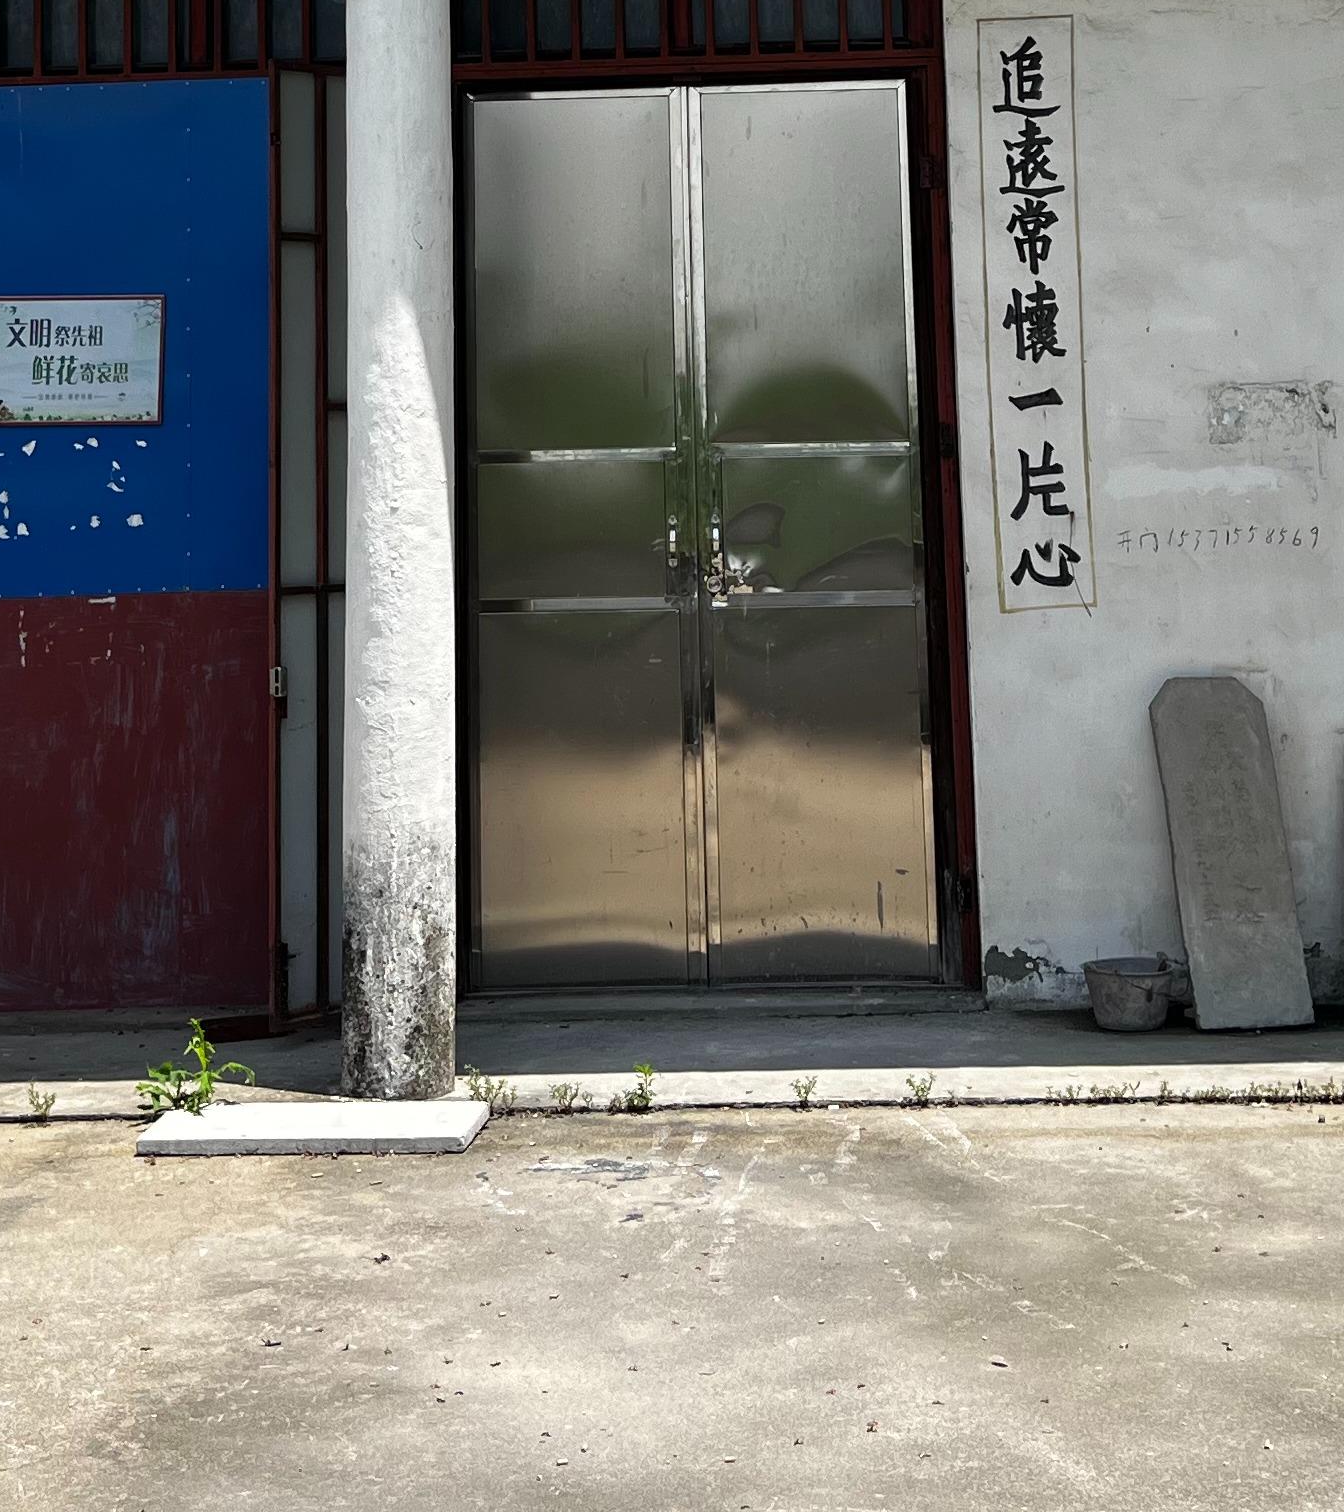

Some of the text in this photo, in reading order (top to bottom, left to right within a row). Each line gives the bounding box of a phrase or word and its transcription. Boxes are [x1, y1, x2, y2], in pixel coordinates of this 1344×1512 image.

[6, 318, 103, 348] 文明祭先祖
[32, 355, 129, 385] 鲜花寄哀思
